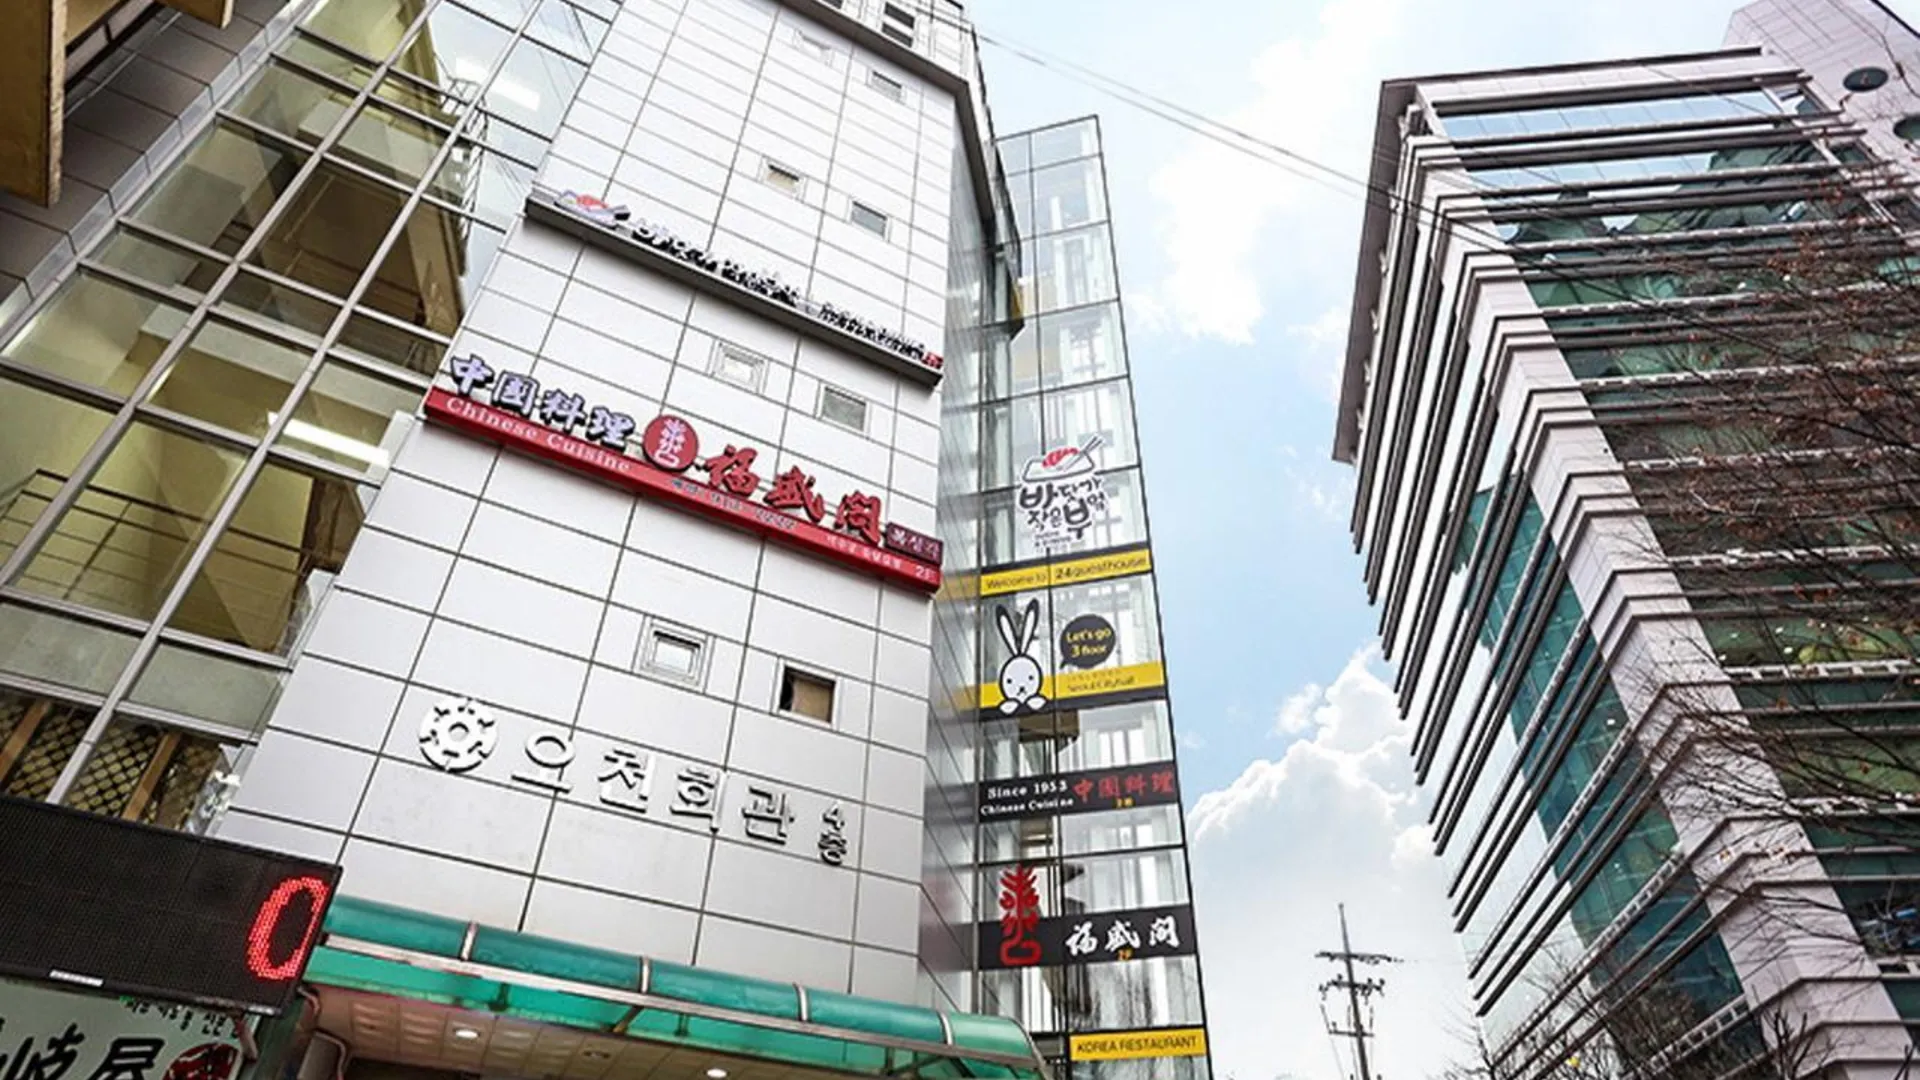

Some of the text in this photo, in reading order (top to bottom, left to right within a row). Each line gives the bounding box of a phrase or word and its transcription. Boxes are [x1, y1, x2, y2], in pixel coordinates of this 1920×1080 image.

[446, 396, 631, 474] Chinese Cuisine
[1094, 628, 1112, 642] go
[988, 784, 1027, 799] Since
[980, 797, 1074, 816] Chinese Cuisine
[1077, 1034, 1197, 1054] KOREA RESTAURANT
